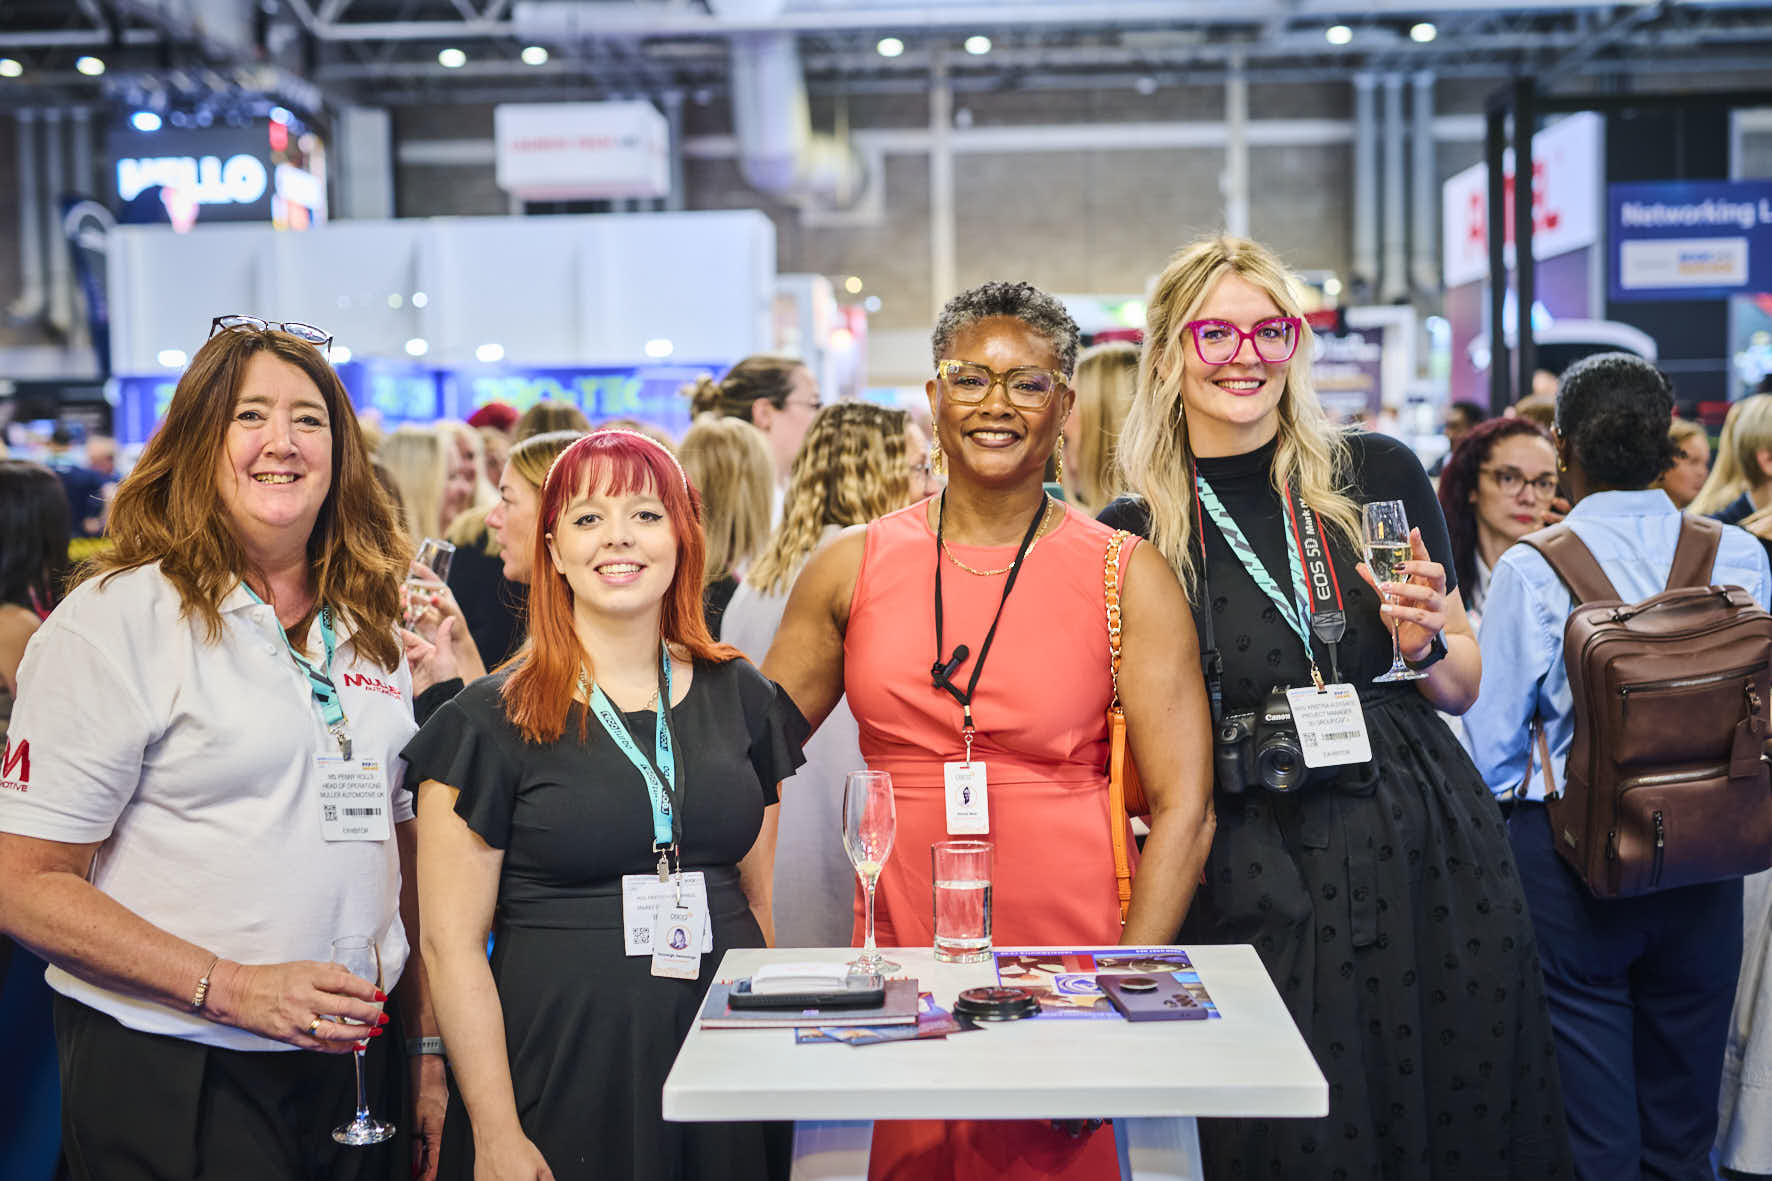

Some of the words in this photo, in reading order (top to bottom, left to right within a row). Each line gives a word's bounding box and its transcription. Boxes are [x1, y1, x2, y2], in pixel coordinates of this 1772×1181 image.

[1621, 200, 1756, 229] Networking
[1301, 509, 1316, 535] Mark
[1303, 537, 1321, 557] 5D
[1309, 560, 1331, 601] EOS
[1264, 713, 1291, 722] Canon
[0, 781, 28, 792] OTIVE
